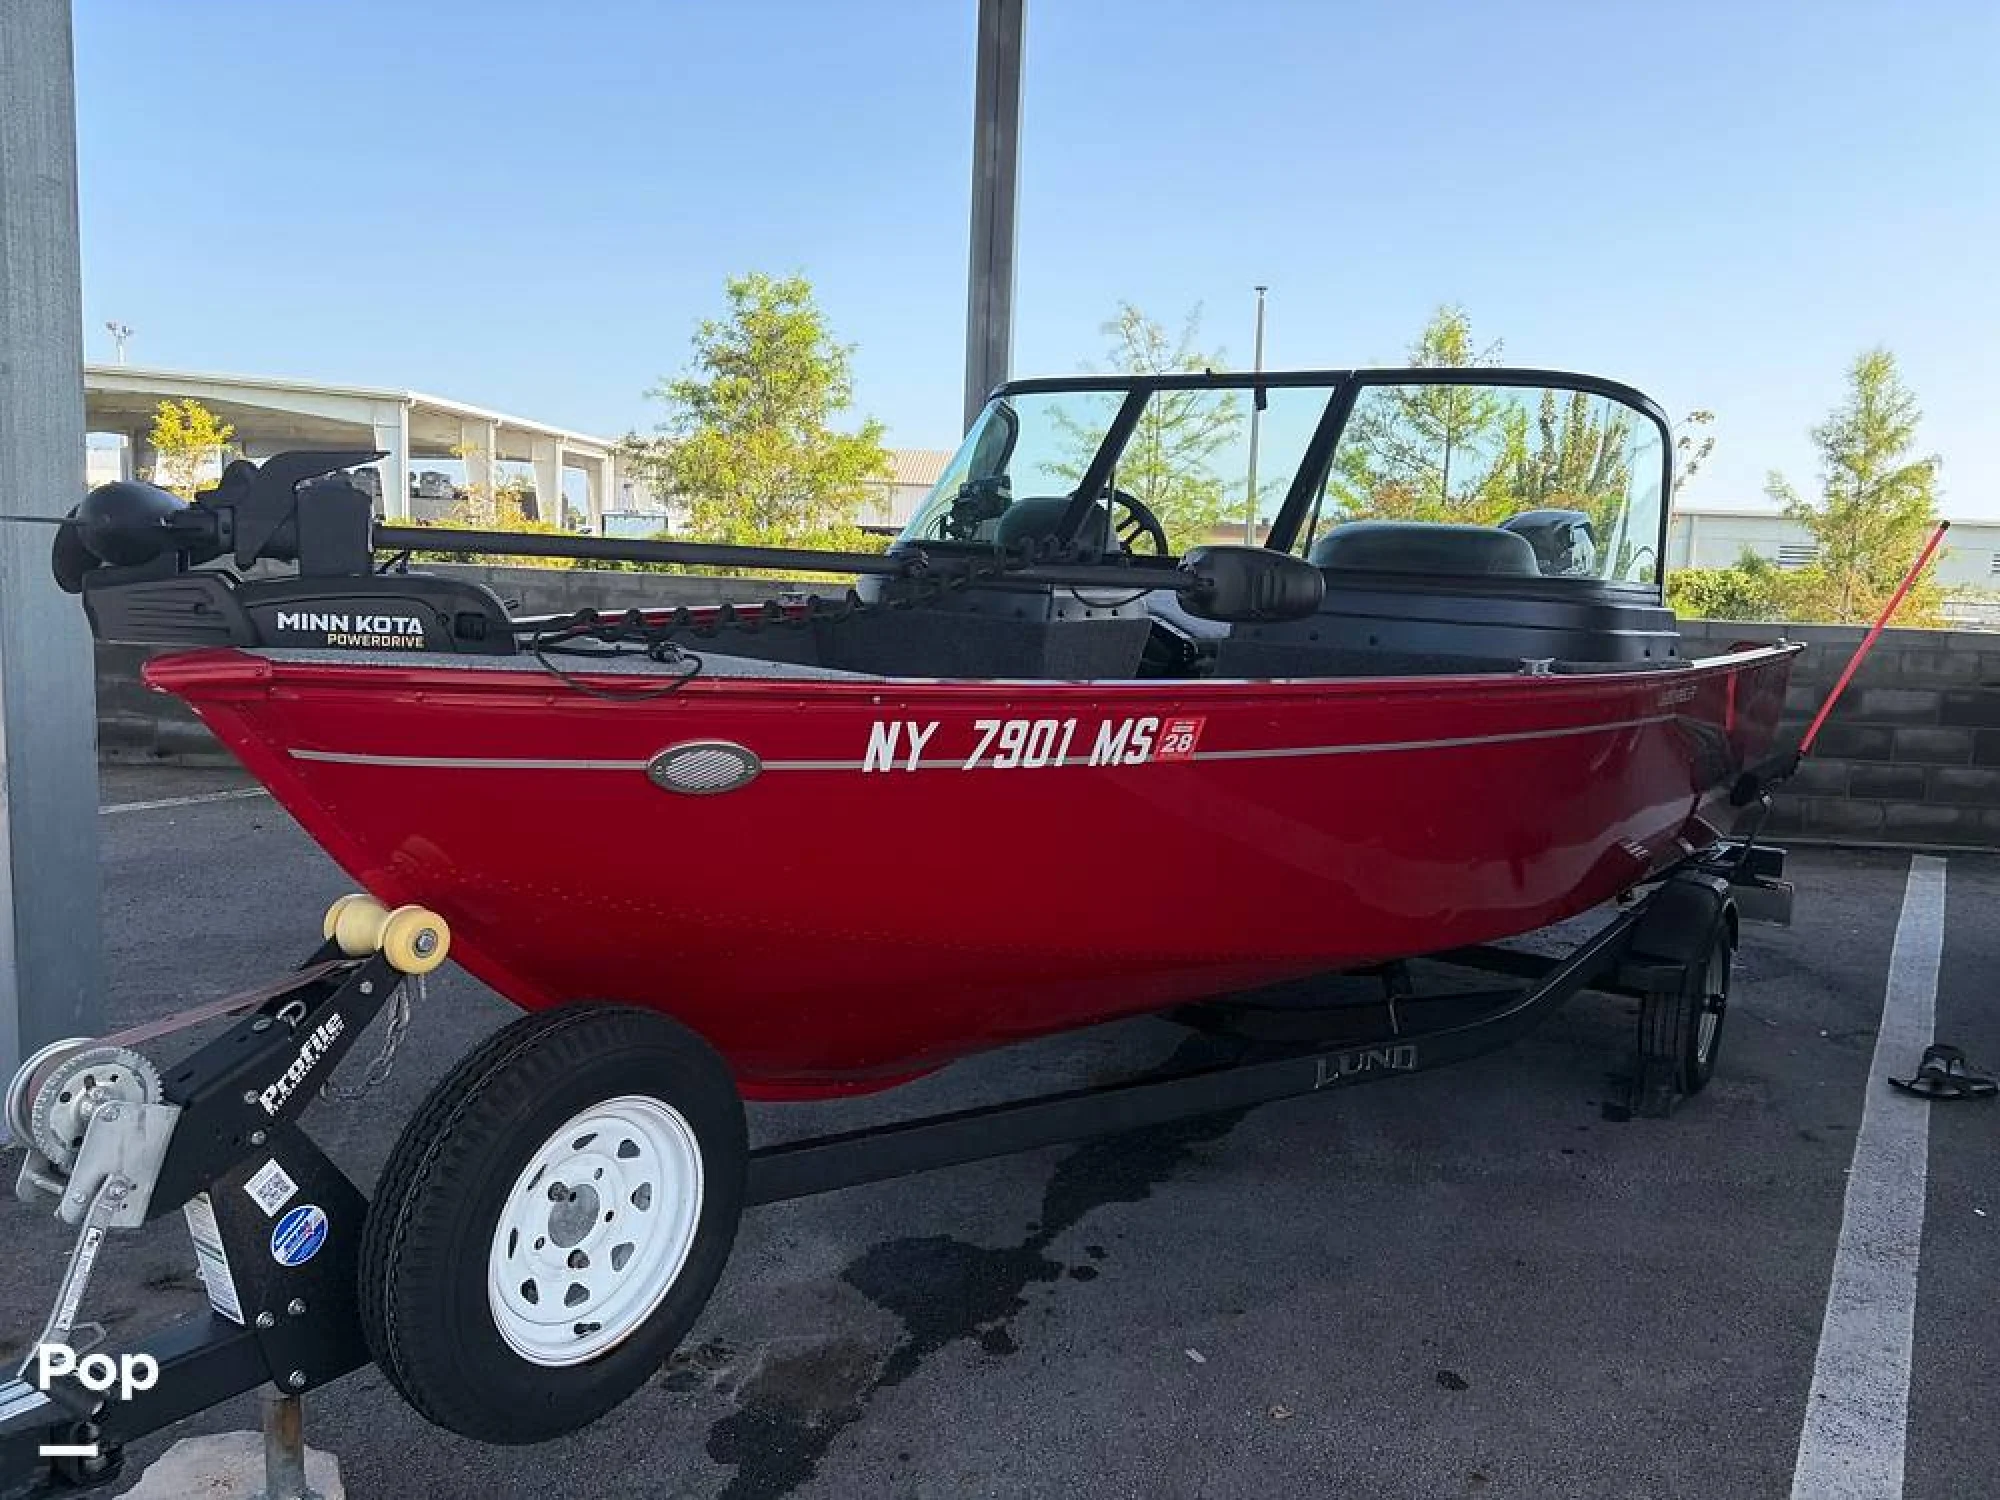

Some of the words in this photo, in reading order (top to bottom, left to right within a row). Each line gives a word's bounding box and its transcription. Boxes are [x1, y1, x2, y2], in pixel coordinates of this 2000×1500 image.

[277, 611, 349, 632] MINN
[355, 615, 424, 635] KOTA
[327, 632, 425, 649] POWERDRIVE
[861, 720, 941, 774] NY
[961, 717, 1079, 771] 7901
[1087, 716, 1159, 767] MS
[1160, 733, 1193, 753] 28
[259, 1012, 343, 1115] Profile
[1313, 1044, 1418, 1090] LUND
